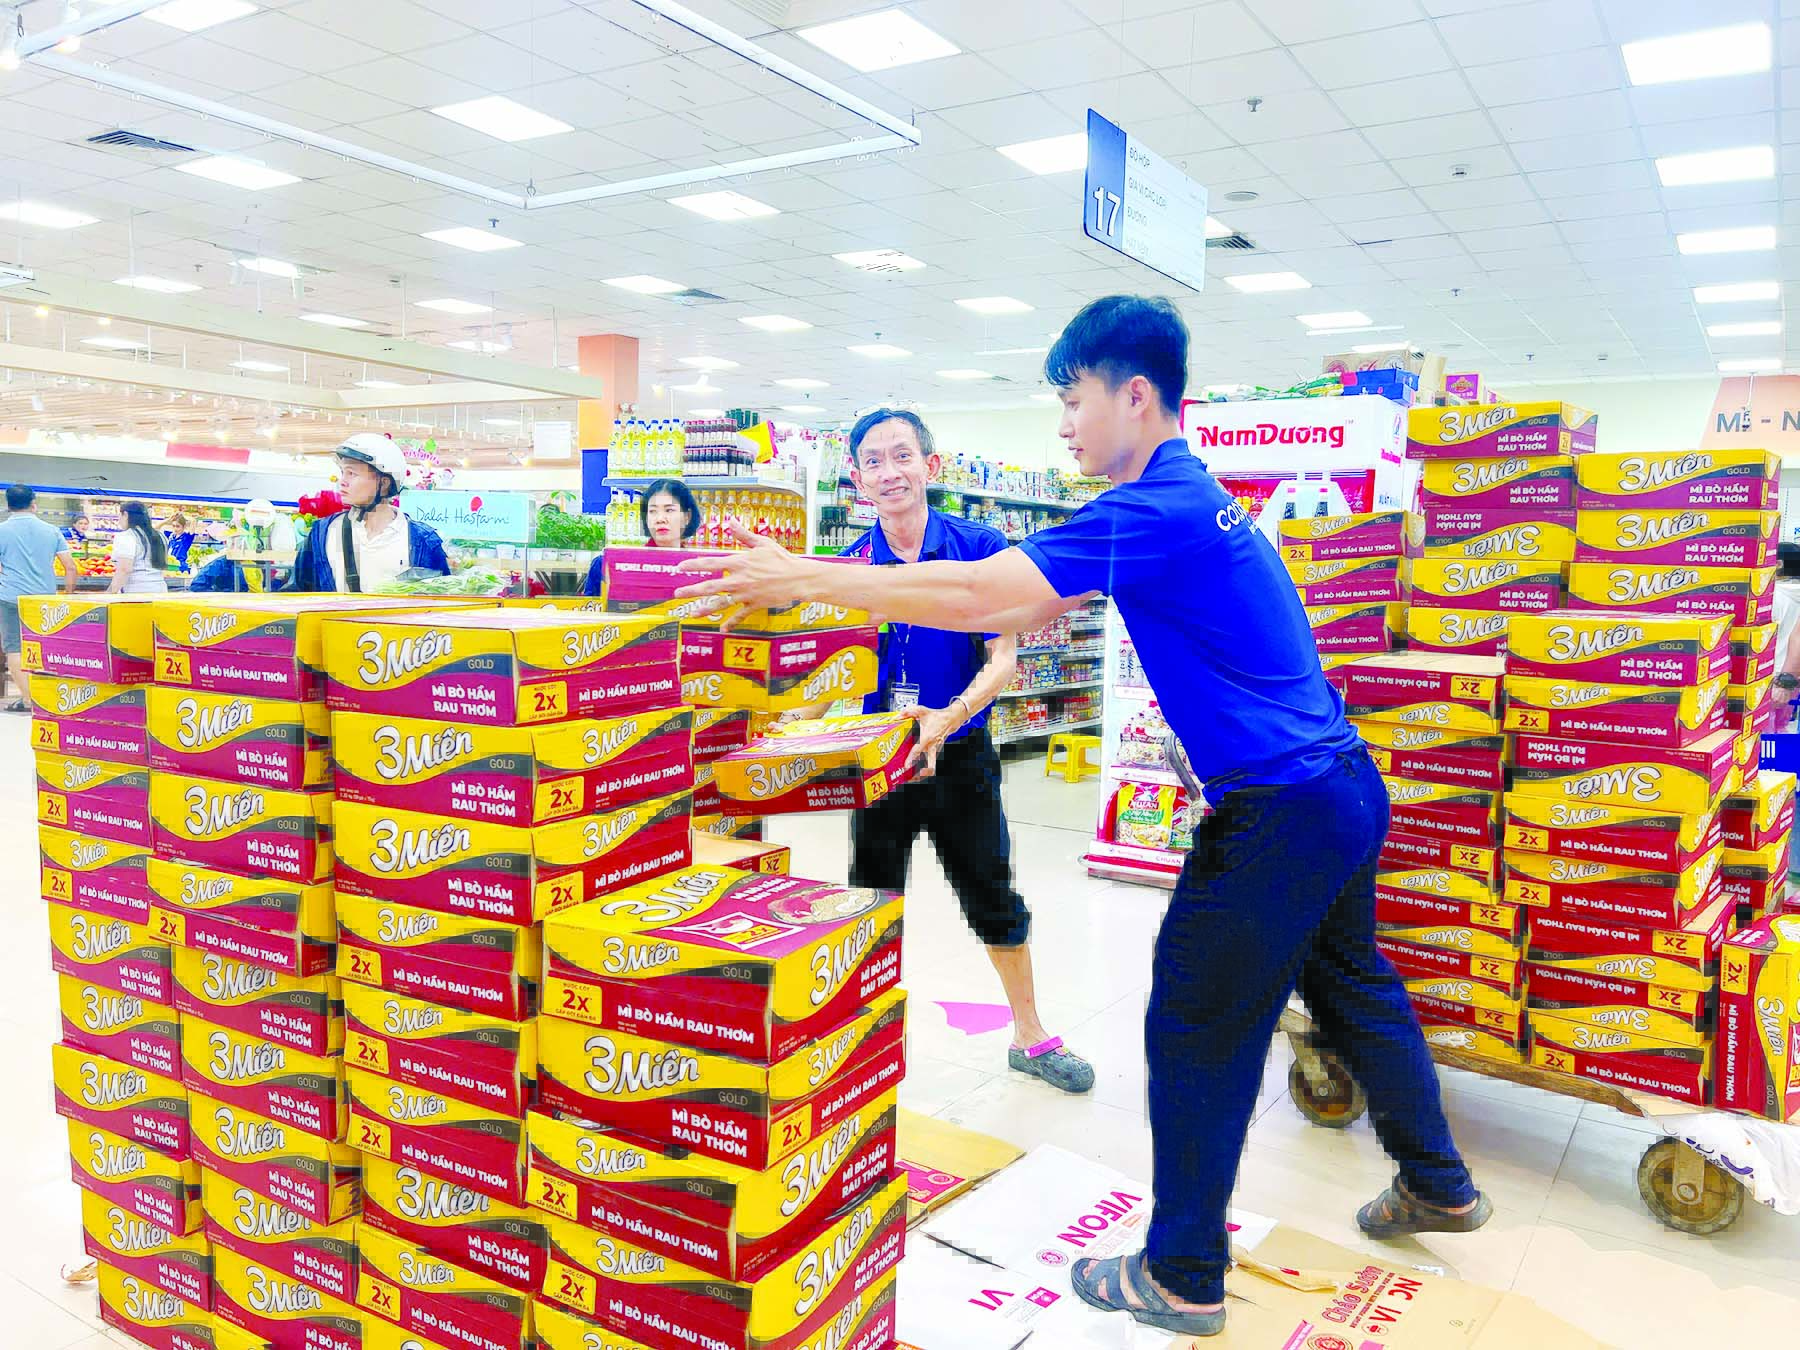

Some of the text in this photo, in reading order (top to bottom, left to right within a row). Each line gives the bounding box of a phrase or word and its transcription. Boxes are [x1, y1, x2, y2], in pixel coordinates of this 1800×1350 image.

[1093, 186, 1121, 236] 17
[1528, 417, 1548, 425] GOLD
[1497, 433, 1508, 442] MÌ
[1509, 433, 1524, 442] BÒ
[1497, 442, 1546, 451] RAU THƠM
[1689, 483, 1702, 493] MÌ
[1704, 483, 1721, 493] BÒ
[1688, 494, 1748, 503] RAU THƠM
[416, 506, 509, 529] Dalat Hasfarm
[1436, 513, 1481, 524] RAU THƠM
[1456, 521, 1469, 530] BÒ
[1470, 521, 1481, 530] MÌ
[264, 626, 283, 635] GOLD
[648, 630, 666, 640] GOLD
[1659, 642, 1684, 651] GOLD
[468, 658, 494, 669] GOLD
[1620, 657, 1634, 667] MÌ
[1636, 658, 1653, 668] BÒ
[199, 665, 209, 675] MÌ
[209, 666, 221, 676] BÒ
[242, 669, 261, 680] RAU
[261, 671, 287, 682] THƠM
[1620, 669, 1682, 680] RAU THƠM
[431, 682, 446, 696] MÌ
[447, 684, 465, 698] BÒ
[578, 688, 590, 701] MÌ
[591, 686, 605, 699] BÒ
[629, 683, 647, 694] RAU
[648, 678, 672, 691] THƠM
[433, 700, 496, 717] RAU THƠM
[265, 728, 286, 737] GOLD
[1560, 719, 1572, 728] MÌ
[1573, 720, 1588, 729] BÒ
[1613, 724, 1635, 733] RAU
[1636, 726, 1667, 735] THƠM
[235, 749, 247, 761] MÌ
[248, 751, 262, 763] BÒ
[237, 764, 288, 782] RAU THƠM
[806, 787, 817, 797] MÌ
[817, 786, 831, 796] BÒ
[808, 795, 855, 806] RAU THƠM
[261, 896, 281, 907] GOLD
[884, 920, 898, 940] GOLD
[472, 934, 496, 945] GOLD
[195, 930, 205, 942] MÌ
[206, 933, 218, 945] BÒ
[240, 944, 258, 957] RAU
[259, 949, 288, 965] THƠM
[141, 950, 158, 960] GOLD
[118, 965, 128, 976] MÌ
[129, 968, 141, 979] BÒ
[722, 966, 751, 979] GOLD
[860, 965, 869, 982] MÌ
[870, 959, 881, 976] BÒ
[120, 978, 161, 998] RAU THƠM
[393, 969, 405, 980] MÌ
[406, 971, 421, 984] BÒ
[447, 981, 469, 994] RAU
[470, 986, 502, 1001] THƠM
[860, 965, 896, 998] RAU THƠM
[617, 1003, 632, 1018] MÌ
[634, 1007, 652, 1022] BÒ
[686, 1019, 713, 1034] RAU
[715, 1025, 753, 1043] THƠM
[718, 1091, 748, 1106] GOLD
[671, 1108, 687, 1123] MÌ
[691, 1113, 711, 1129] BÒ
[672, 1124, 746, 1157] RAU THƠM
[1057, 1191, 1143, 1248] VIFON
